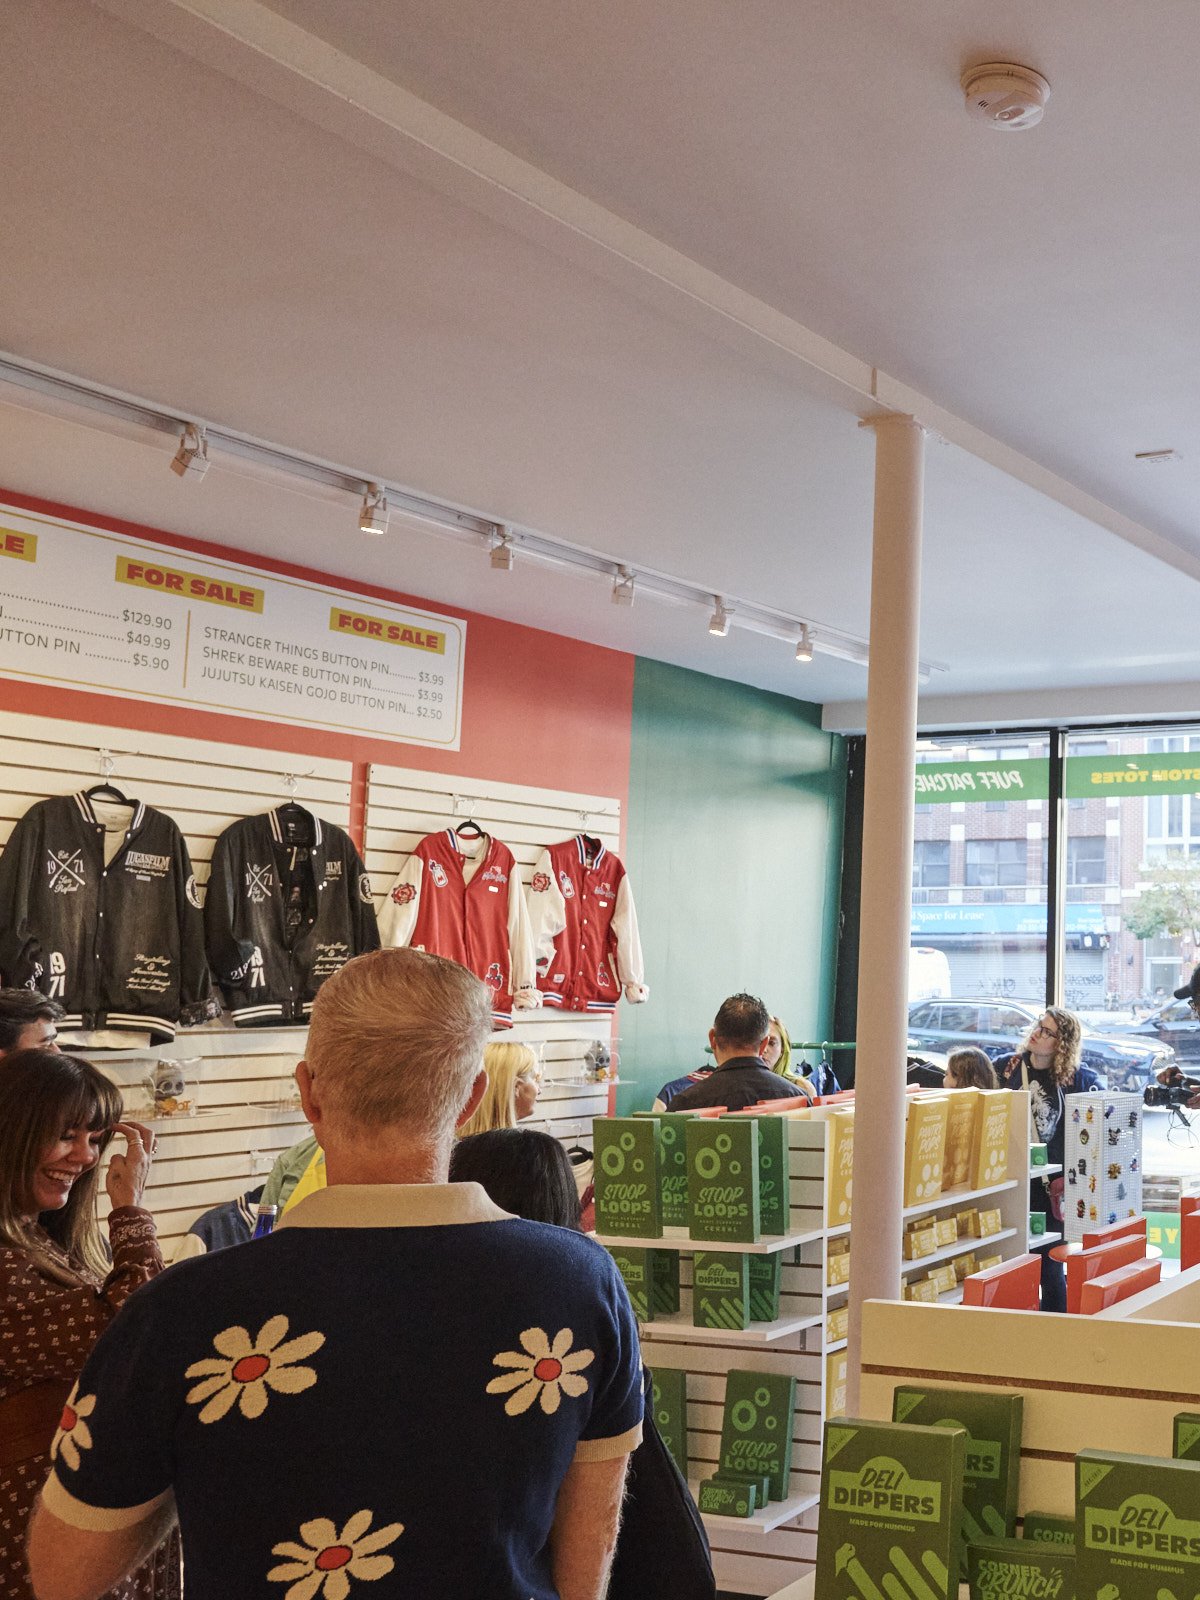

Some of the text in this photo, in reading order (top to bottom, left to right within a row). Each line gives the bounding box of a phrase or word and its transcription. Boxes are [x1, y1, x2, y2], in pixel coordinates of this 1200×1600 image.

[127, 563, 255, 608] FOR SALE
[123, 609, 172, 630] $129.90
[127, 631, 171, 650] $49.99
[338, 613, 439, 649] FOR SALE
[0, 628, 170, 671] TTON PIN $5.90
[204, 626, 444, 686] STRANGER THINGS BUTTON PIN $3.99
[203, 646, 443, 703] SHREK BEWARE BUTTON PIN $3.99
[202, 666, 443, 720] JUJUTSU KAISEN GOJO BUTTON PIN $2.50
[49, 951, 66, 975] 19
[48, 975, 67, 999] 71
[250, 967, 266, 988] 71
[603, 1183, 647, 1200] STOOP
[661, 1175, 688, 1192] OOP
[661, 1191, 688, 1205] OPS
[699, 1186, 744, 1203] STOOP
[600, 1200, 651, 1215] LOOPS
[694, 1203, 749, 1218] LOOPS
[698, 1275, 738, 1285] DIPPERS
[707, 1266, 725, 1276] DELI
[729, 1439, 778, 1458] STOOP
[724, 1455, 780, 1474] LOOPS
[860, 1467, 905, 1491] DELI
[834, 1486, 934, 1516] DIPPERS
[850, 1518, 869, 1528] MADE
[870, 1520, 884, 1529] FOR
[1119, 1505, 1170, 1531] DELI
[1033, 1528, 1075, 1545] CORN
[978, 1559, 1042, 1578] CORNER
[1110, 1558, 1185, 1574] MADE FOR HUMMUS
[976, 1570, 1064, 1599] CRUNCH
